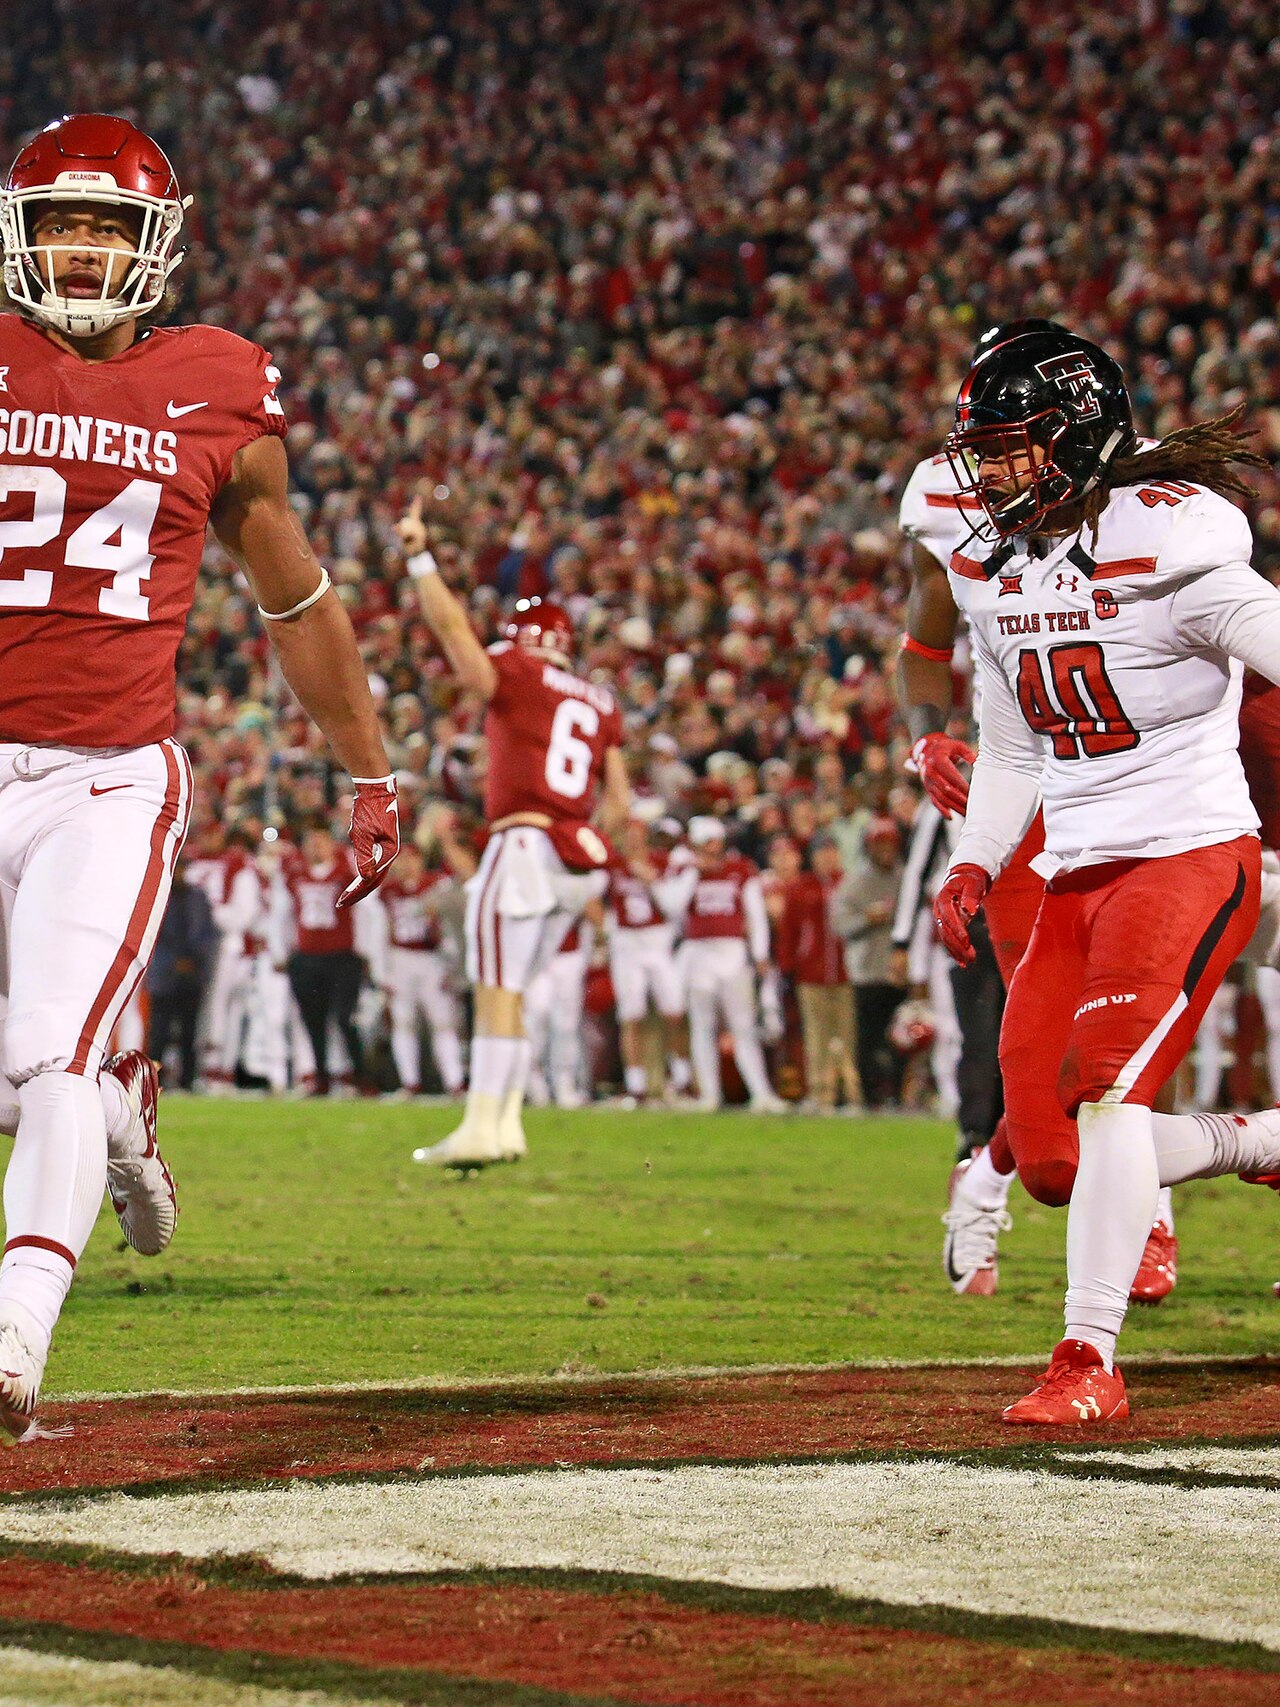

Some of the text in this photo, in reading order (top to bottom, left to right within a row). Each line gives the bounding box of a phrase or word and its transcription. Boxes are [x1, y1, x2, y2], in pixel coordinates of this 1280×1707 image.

[68, 173, 101, 181] OKLAHOMA
[1092, 589, 1119, 620] C
[997, 611, 1090, 635] TEXAS TECH
[1016, 641, 1141, 760] 40
[545, 698, 599, 798] 6
[1110, 993, 1138, 1004] UP
